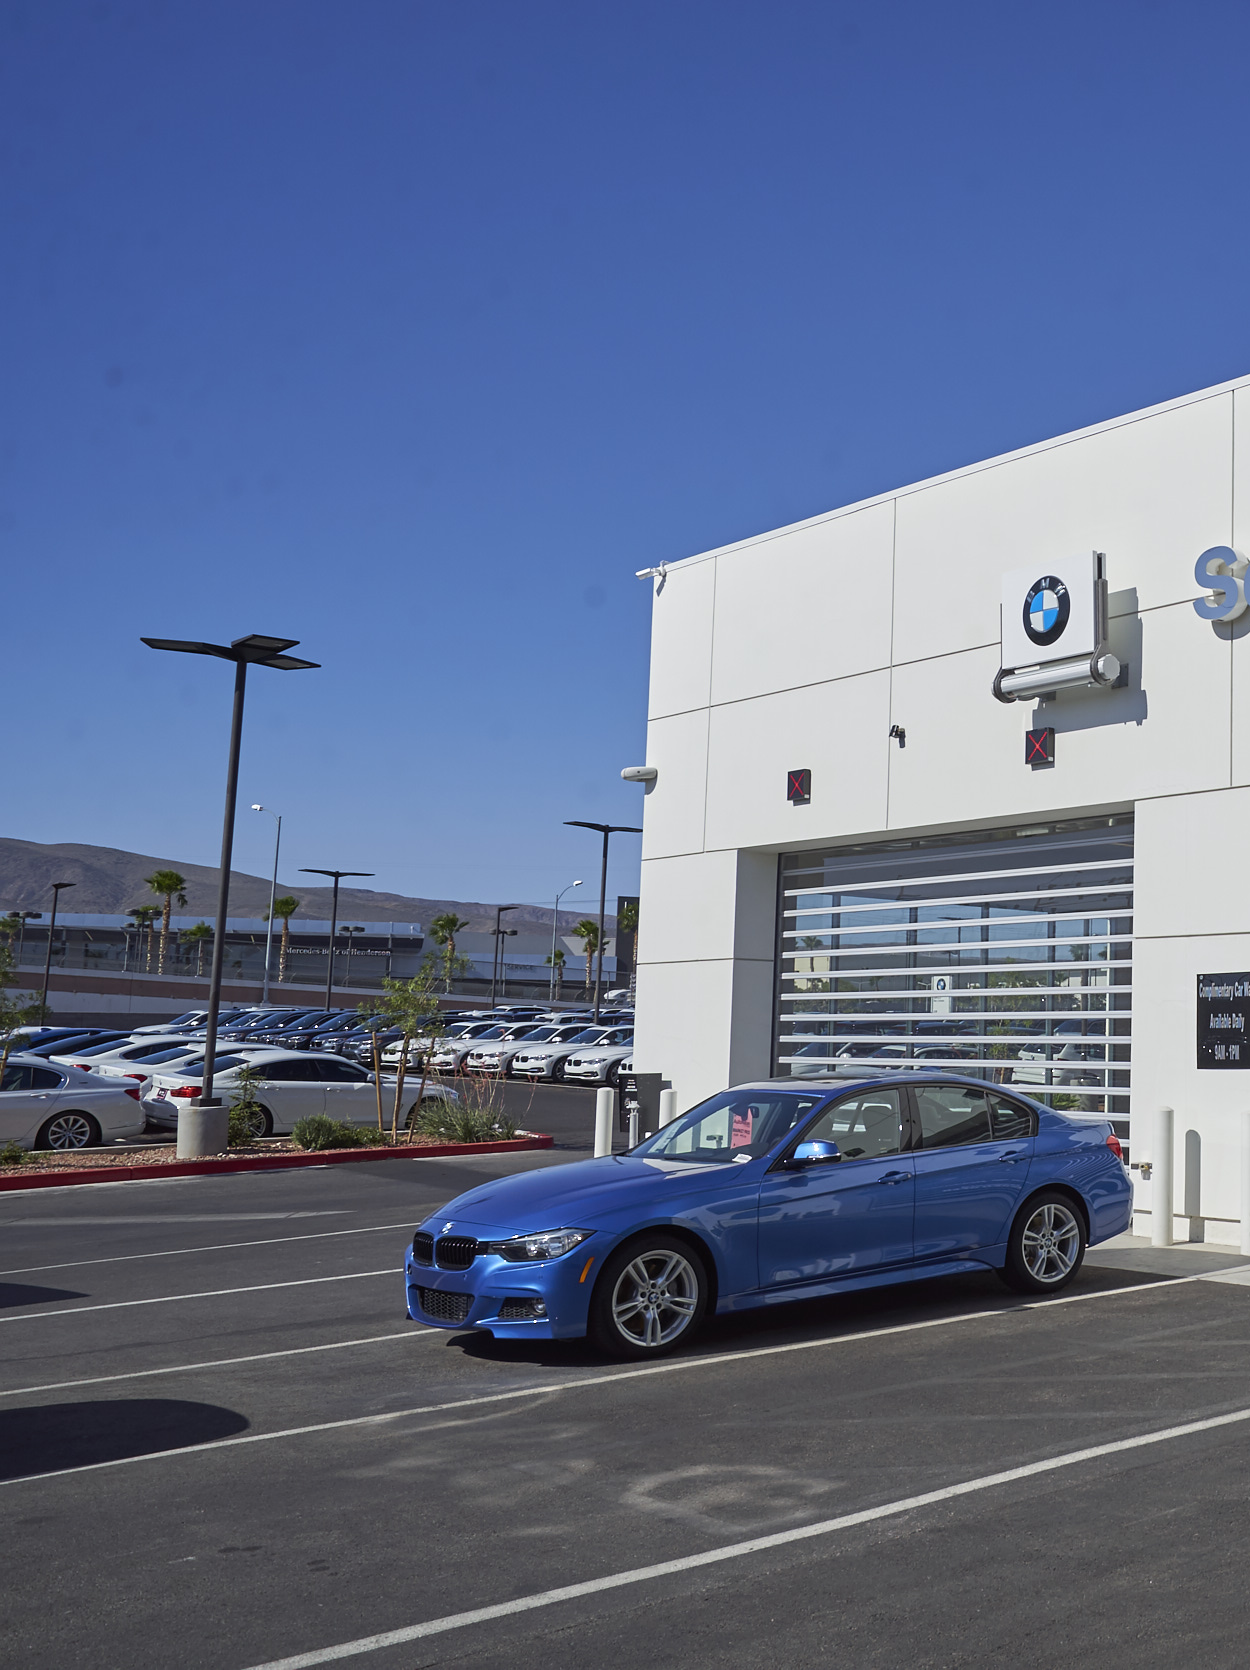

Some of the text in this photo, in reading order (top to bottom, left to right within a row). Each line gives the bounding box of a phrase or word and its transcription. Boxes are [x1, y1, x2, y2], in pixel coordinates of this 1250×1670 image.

[1026, 577, 1066, 603] BMW
[286, 946, 340, 955] Mercedes-Bez
[350, 948, 391, 956] Henderson
[1199, 982, 1234, 1001] Complimentary
[1234, 981, 1243, 997] Car
[1209, 1013, 1245, 1033] Available Daily
